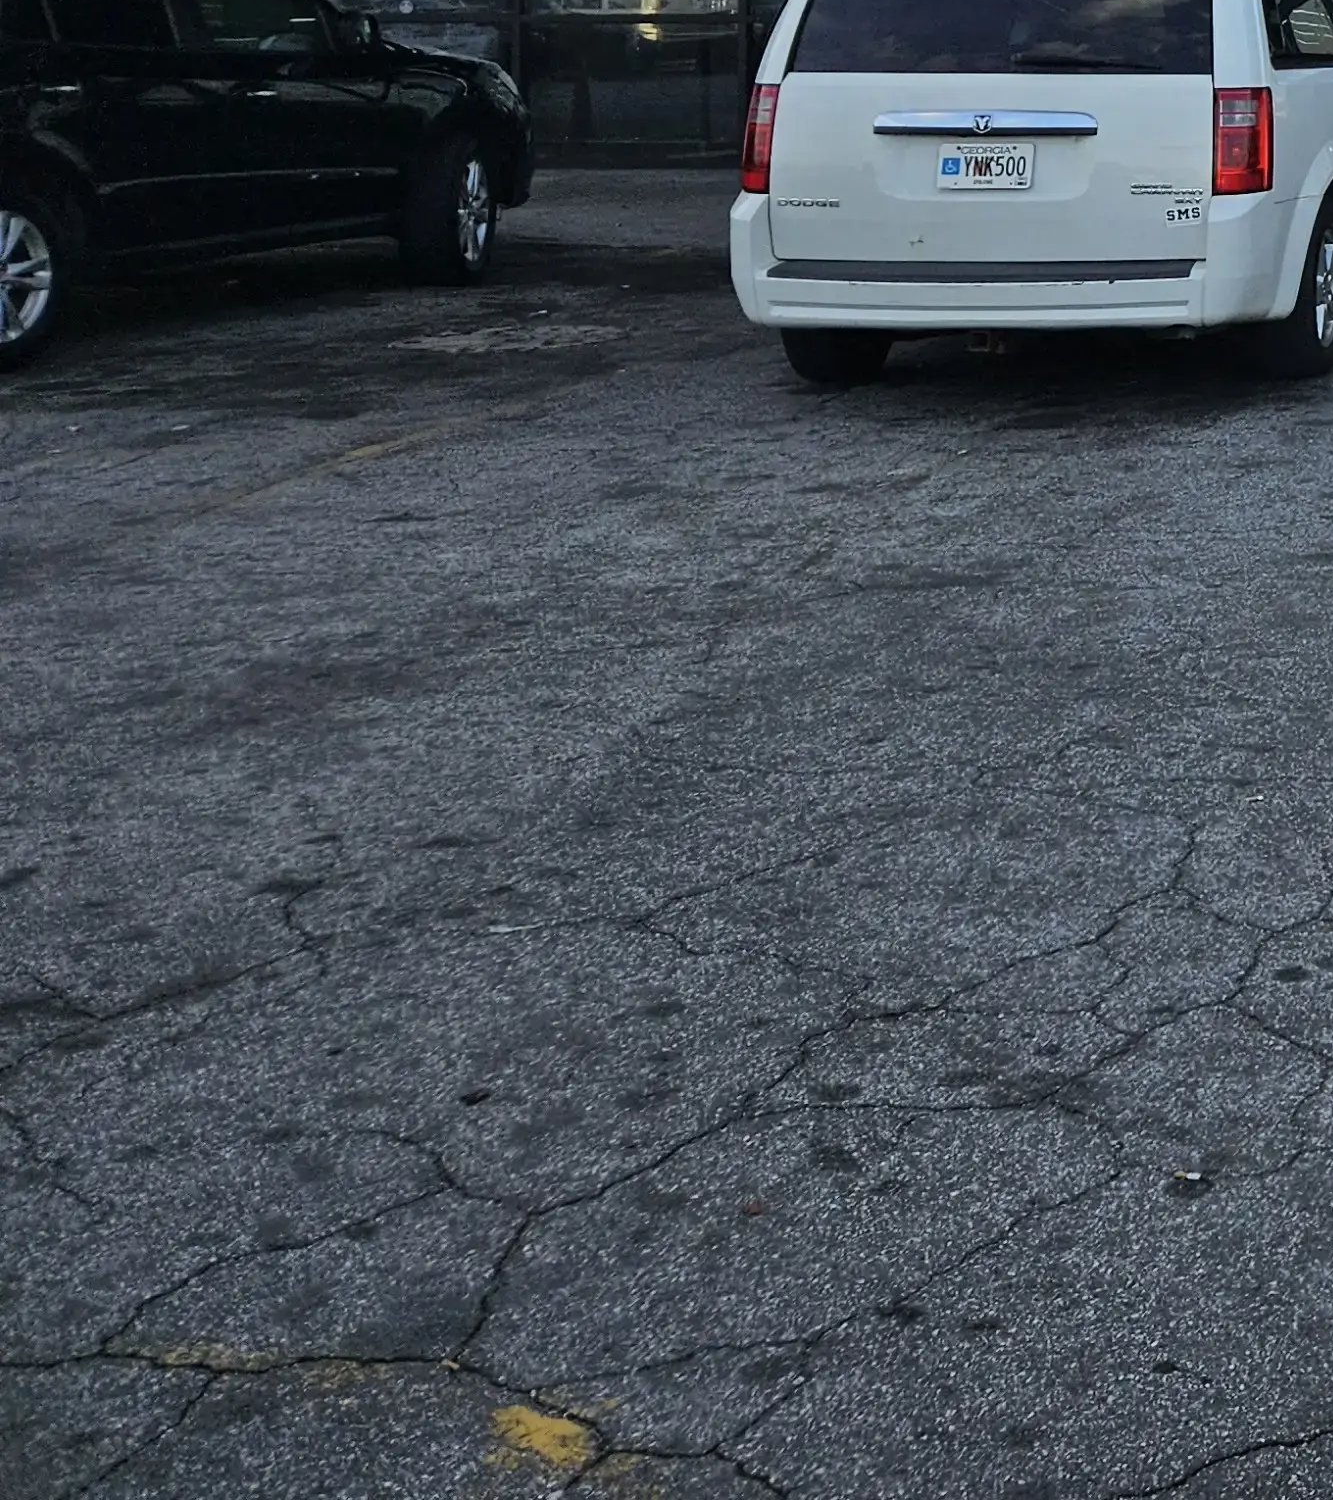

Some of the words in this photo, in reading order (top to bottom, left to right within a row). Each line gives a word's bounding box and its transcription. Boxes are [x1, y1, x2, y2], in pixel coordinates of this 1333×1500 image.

[961, 146, 1012, 155] GEORGIA
[964, 156, 1027, 177] YNK500
[777, 197, 840, 208] DODGE
[1166, 206, 1201, 221] SMS
